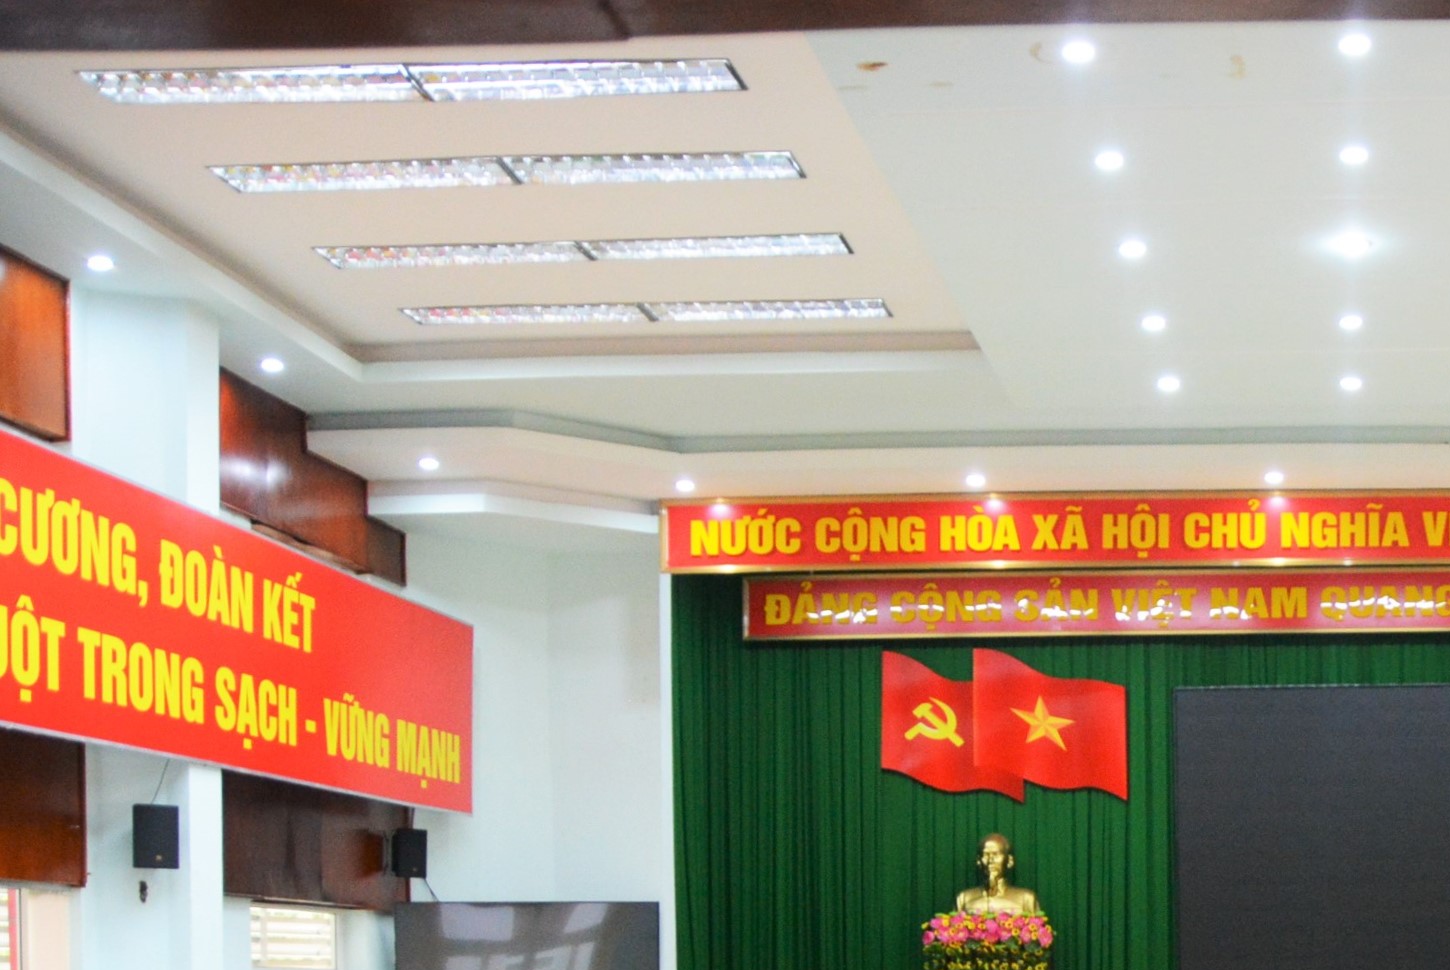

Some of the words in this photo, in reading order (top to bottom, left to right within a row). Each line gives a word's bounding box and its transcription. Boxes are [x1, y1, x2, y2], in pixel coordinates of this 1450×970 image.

[690, 508, 802, 557] NƯỚC
[815, 507, 926, 561] CỘNG
[939, 506, 1020, 551] HÒA
[1031, 507, 1089, 551] XÃ
[1102, 507, 1171, 559] HỘI
[1183, 499, 1263, 551] CHỦ
[1280, 503, 1410, 549] NGHĨA
[158, 539, 254, 633] ĐOÀN
[263, 572, 316, 653] KẾT
[764, 581, 877, 625] ĐẢNG
[889, 583, 1002, 630] CỘNG
[1013, 577, 1098, 621] SẢN
[1111, 580, 1196, 627] VIỆT
[1209, 586, 1308, 620] NAM
[77, 627, 205, 724] TRONG
[215, 666, 297, 750] SẠCH
[323, 693, 390, 768] VỮNG
[396, 719, 461, 788] MẠNH
